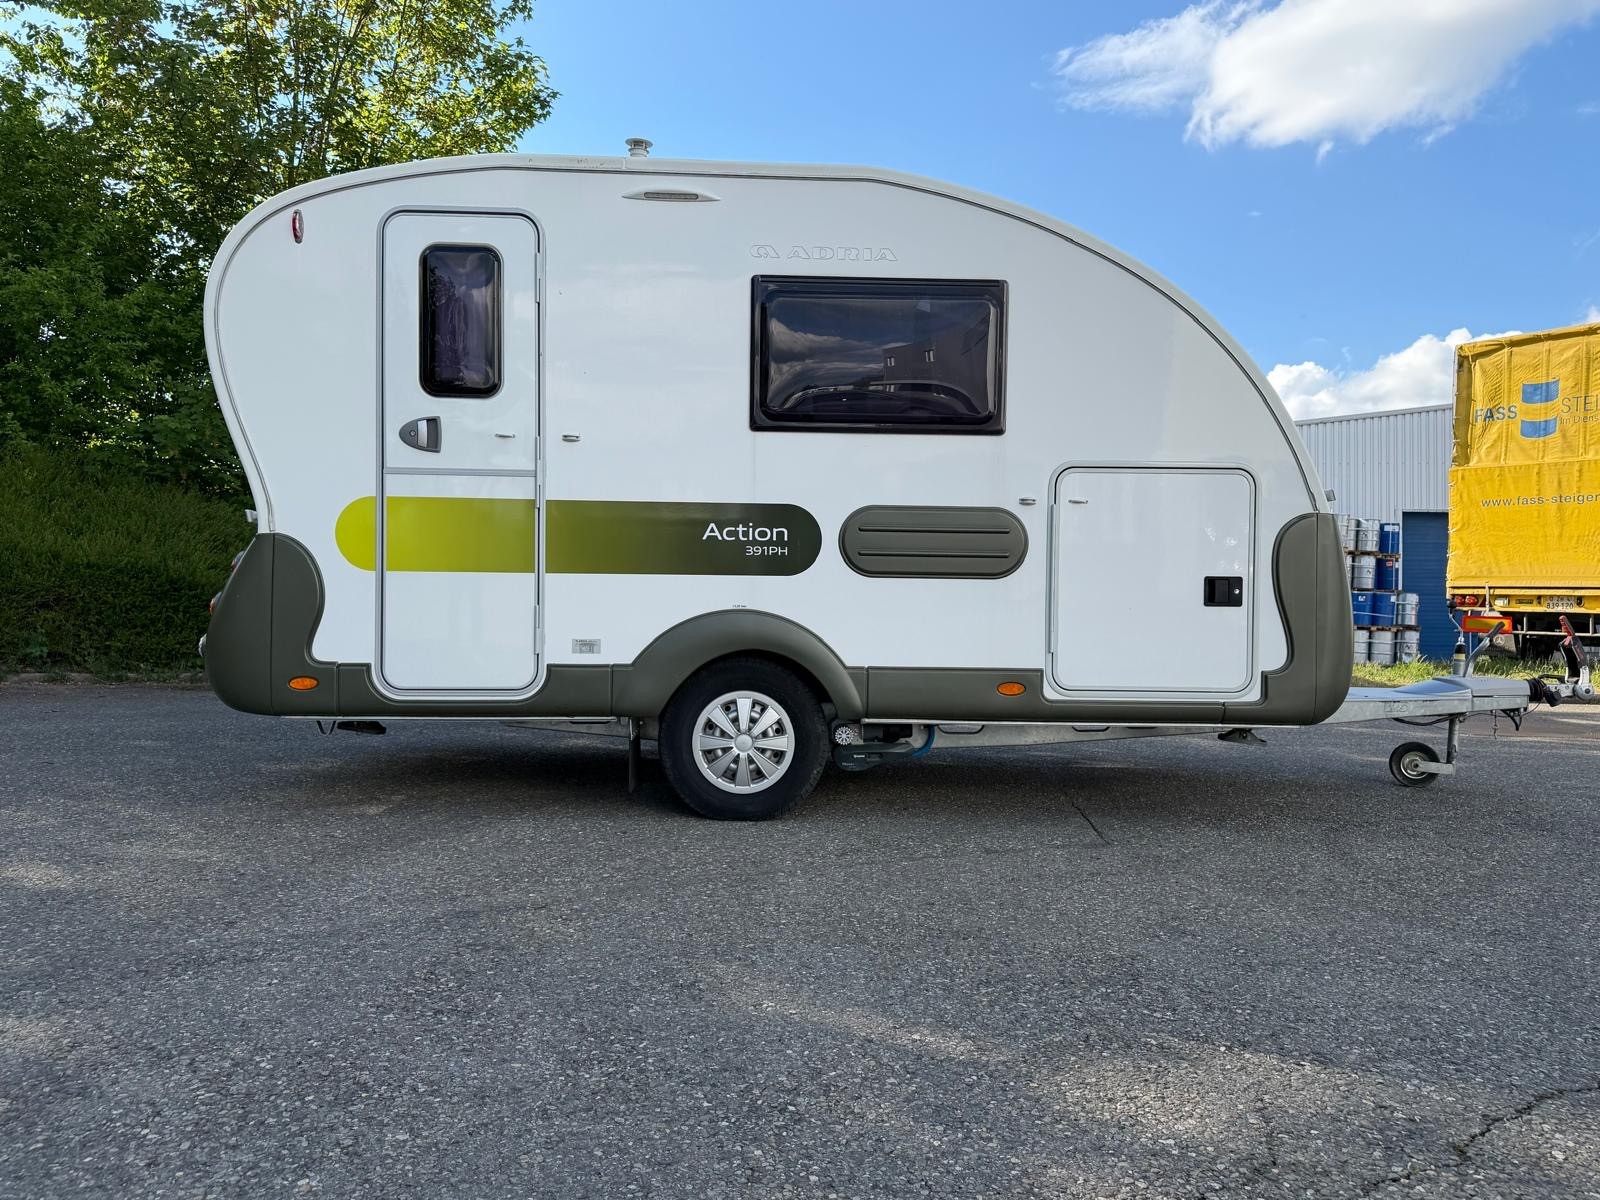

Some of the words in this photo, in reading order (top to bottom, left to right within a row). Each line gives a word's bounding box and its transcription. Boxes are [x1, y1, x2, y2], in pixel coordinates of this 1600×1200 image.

[787, 245, 898, 262] ADRIA
[1475, 404, 1518, 423] FASS
[702, 522, 788, 541] Action
[745, 545, 788, 556] 391PH
